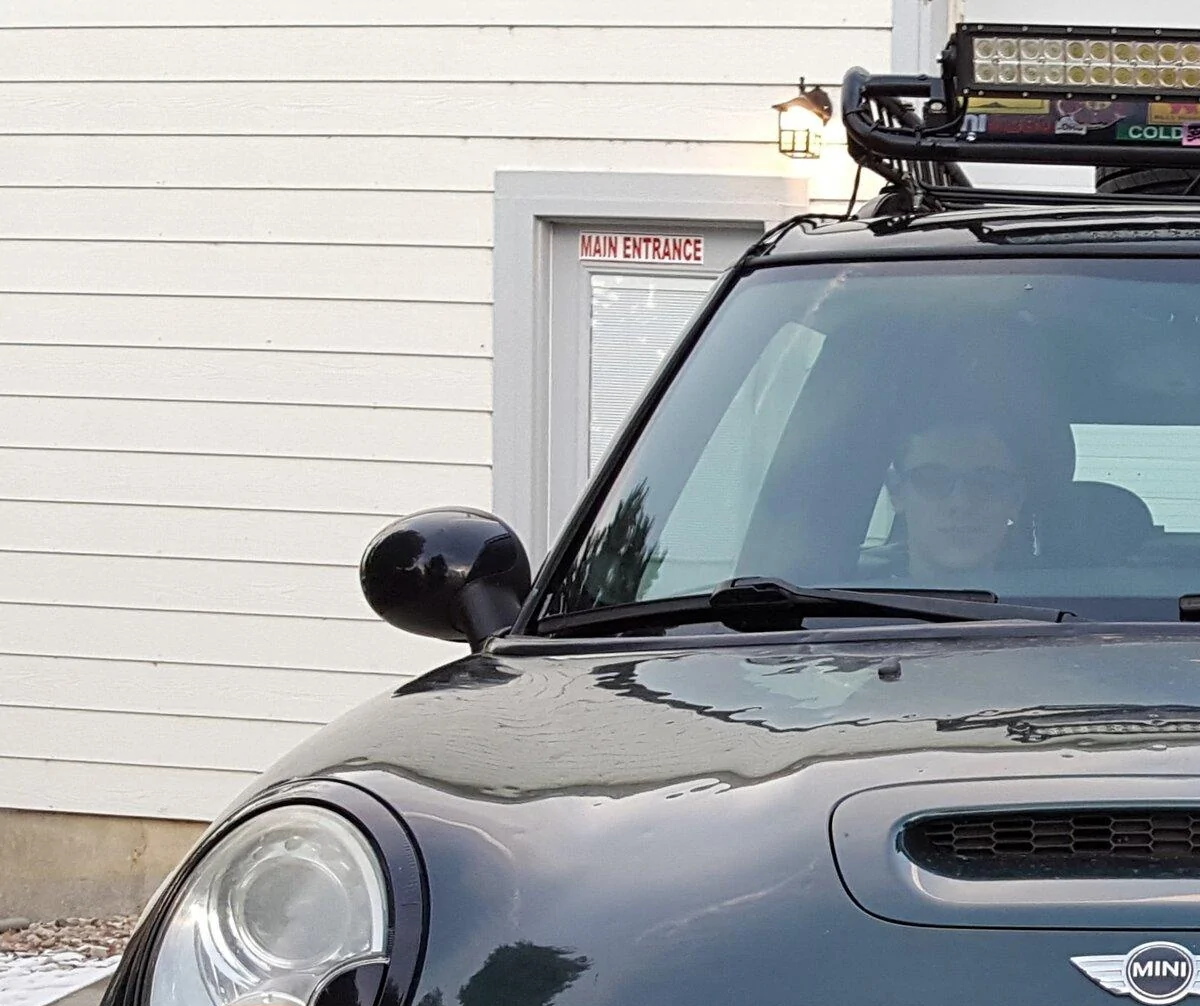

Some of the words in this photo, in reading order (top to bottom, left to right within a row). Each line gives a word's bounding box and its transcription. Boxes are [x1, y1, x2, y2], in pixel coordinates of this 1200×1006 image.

[1128, 125, 1184, 139] COLD
[580, 234, 618, 258] MAIN
[622, 236, 703, 261] ENTRANCE
[1132, 960, 1187, 978] MINI
